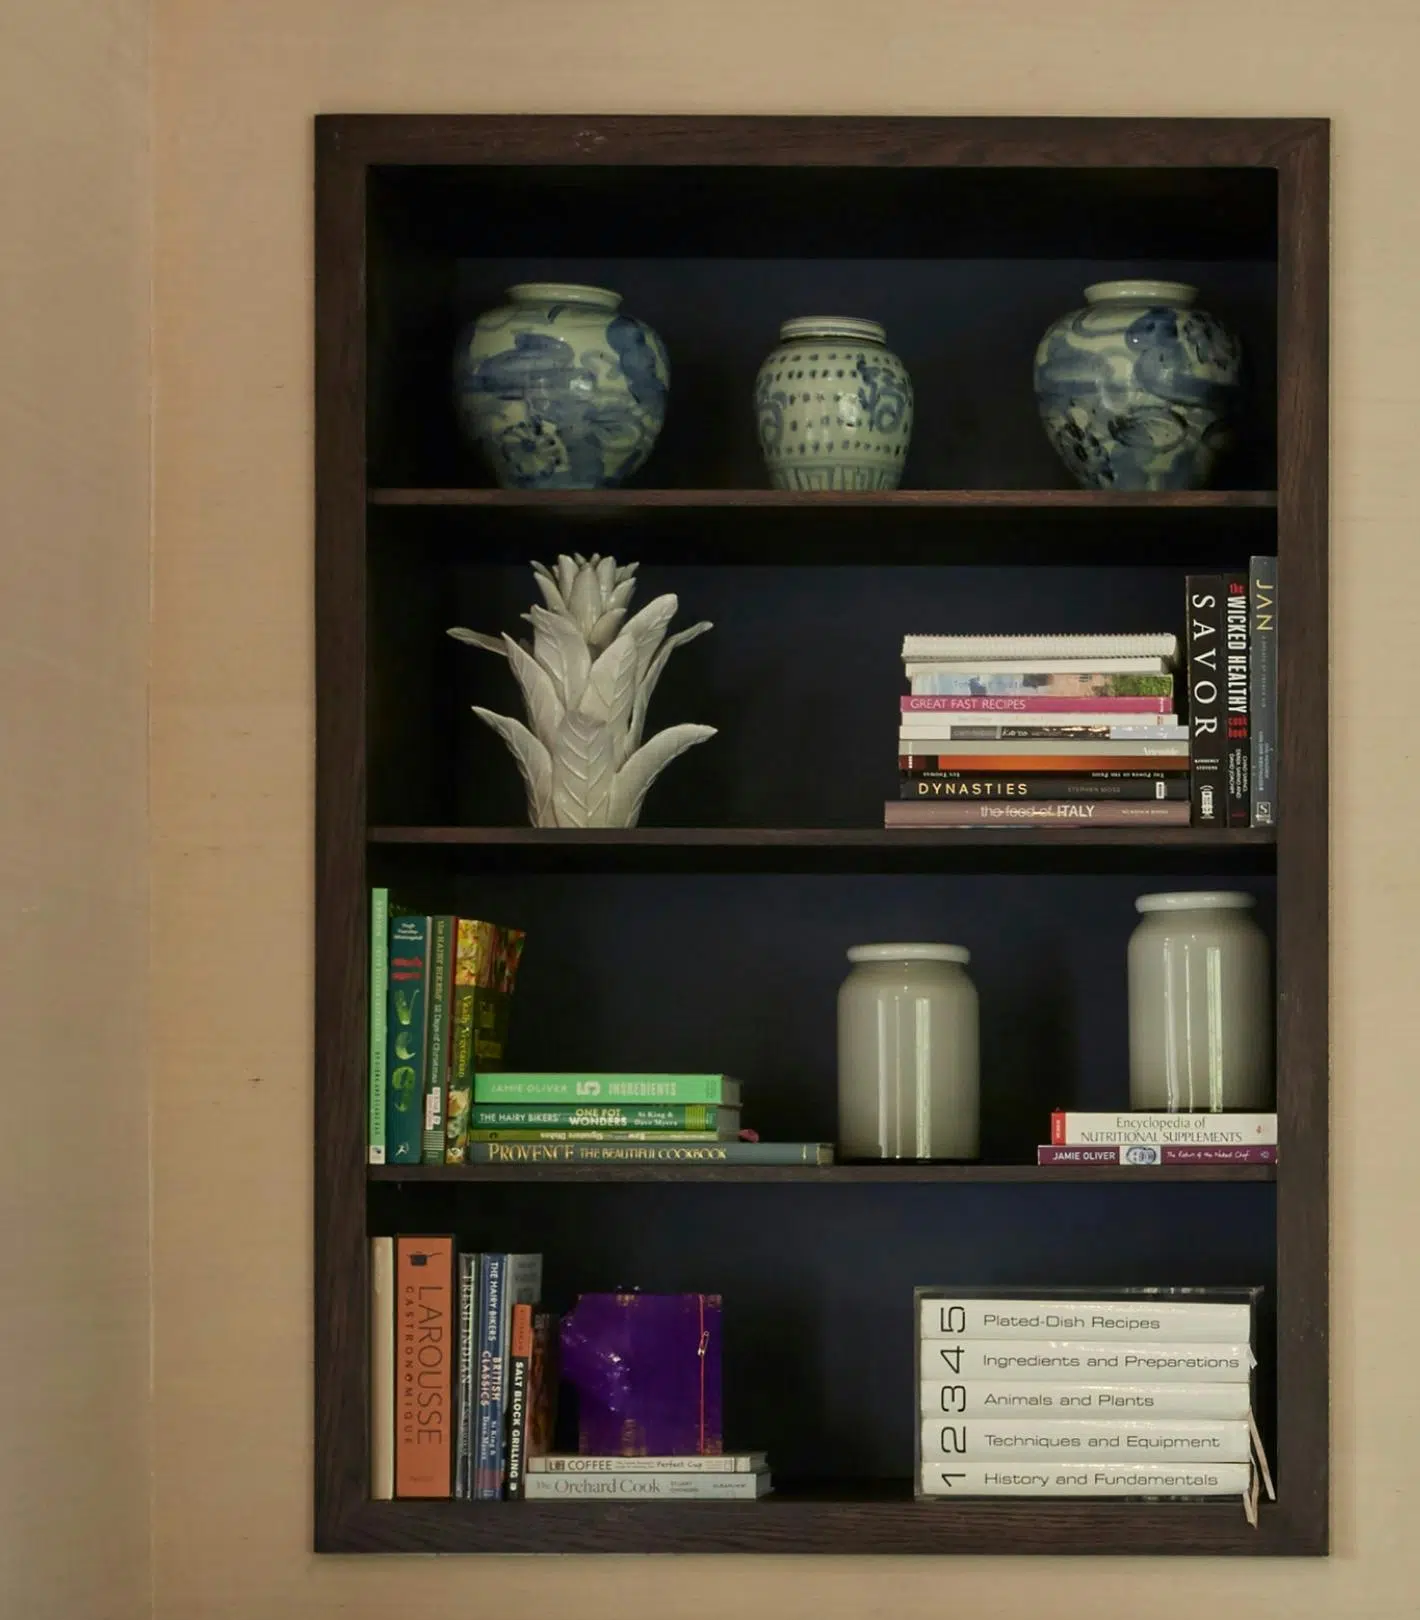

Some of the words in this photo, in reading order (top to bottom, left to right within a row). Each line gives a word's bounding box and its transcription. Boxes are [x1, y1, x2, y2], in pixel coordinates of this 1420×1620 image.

[1256, 579, 1273, 631] JAN
[1227, 596, 1247, 650] WICKED
[1192, 594, 1218, 737] SAVOR
[1228, 656, 1247, 713] HEALTHY
[910, 699, 946, 710] GREAT
[951, 699, 976, 710] FAST
[982, 699, 1026, 710] RECIPES
[918, 783, 1028, 795] DYNASTIES
[980, 805, 1003, 818] the
[1004, 804, 1035, 818] food
[1057, 804, 1095, 818] ITALY
[491, 1083, 521, 1093] JAMIE
[525, 1083, 568, 1093] OLIVER
[576, 1079, 601, 1096] 5
[608, 1079, 677, 1097] INGREDIENTS
[479, 1112, 496, 1123] THE
[498, 1112, 526, 1123] HAIRY
[568, 1116, 628, 1127] WONDERS
[575, 1108, 596, 1117] ONE
[598, 1108, 621, 1117] POT
[1116, 1116, 1190, 1130] Encyclopedia
[1193, 1116, 1207, 1129] of
[1081, 1131, 1159, 1143] NUTRITIONAL
[1163, 1131, 1243, 1143] SUPPLEMENTS
[488, 1143, 575, 1162] PROVENCE
[580, 1149, 598, 1160] THE
[601, 1148, 655, 1160] BEAUTIFUL
[658, 1147, 728, 1161] COOKBOOK
[1052, 1151, 1080, 1161] JAMIE
[1083, 1151, 1116, 1161] OLIVER
[490, 1262, 499, 1279] THE
[489, 1281, 498, 1309] HAIRY
[487, 1311, 497, 1341] BIKERS
[940, 1305, 966, 1333] 5
[983, 1314, 1085, 1329] Plated-Dish
[1091, 1315, 1160, 1331] Recipes
[404, 1286, 415, 1444] GASTRONOMIQUE
[460, 1328, 472, 1384] INDIAN
[940, 1345, 965, 1374] 4
[983, 1355, 1081, 1371] Ingredients
[1087, 1355, 1118, 1368] and
[1125, 1356, 1240, 1371] Preparations
[417, 1286, 443, 1445] LAROUSSE
[514, 1361, 524, 1388] SALT
[480, 1350, 490, 1407] CLASSICS
[491, 1356, 501, 1400] BRITISH
[940, 1385, 966, 1413] 3
[984, 1393, 1053, 1407] Animals
[1060, 1394, 1092, 1407] and
[1098, 1394, 1154, 1407] Plants
[512, 1391, 523, 1427] BLOCK
[940, 1426, 966, 1454] 2
[985, 1434, 1081, 1449] Techniques
[1088, 1435, 1120, 1448] and
[1127, 1435, 1220, 1450] Equipment
[509, 1429, 521, 1478] GRILLING
[568, 1459, 613, 1471] COFFEE
[656, 1460, 685, 1469] Perfect
[687, 1460, 703, 1470] Cup
[554, 1478, 617, 1494] Orchard
[620, 1478, 661, 1494] Cook
[940, 1473, 966, 1487] 1
[984, 1473, 1049, 1489] History
[1055, 1473, 1088, 1486] and
[1094, 1473, 1219, 1486] Fundamentals
